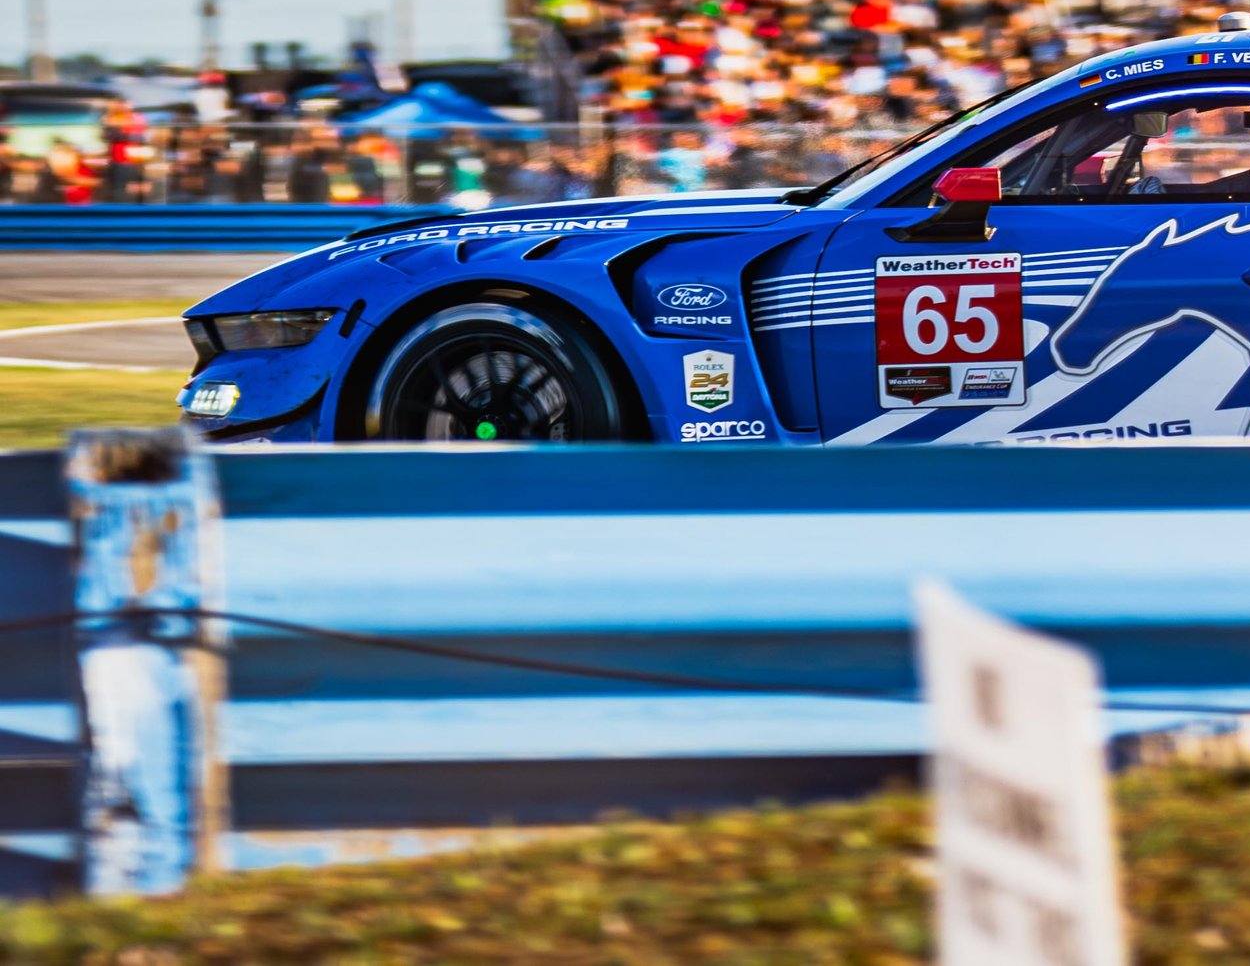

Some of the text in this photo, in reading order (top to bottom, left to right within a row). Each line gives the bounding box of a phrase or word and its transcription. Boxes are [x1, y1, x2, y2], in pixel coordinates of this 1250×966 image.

[1214, 52, 1227, 64] F.
[1105, 59, 1165, 80] C. MIES
[327, 218, 630, 260] FORD RACING
[882, 257, 1016, 272] WeatherTech
[671, 287, 713, 306] Ford
[654, 316, 732, 325] RACING
[902, 284, 1000, 355] 65
[690, 372, 729, 388] 24
[681, 420, 765, 442] sparco
